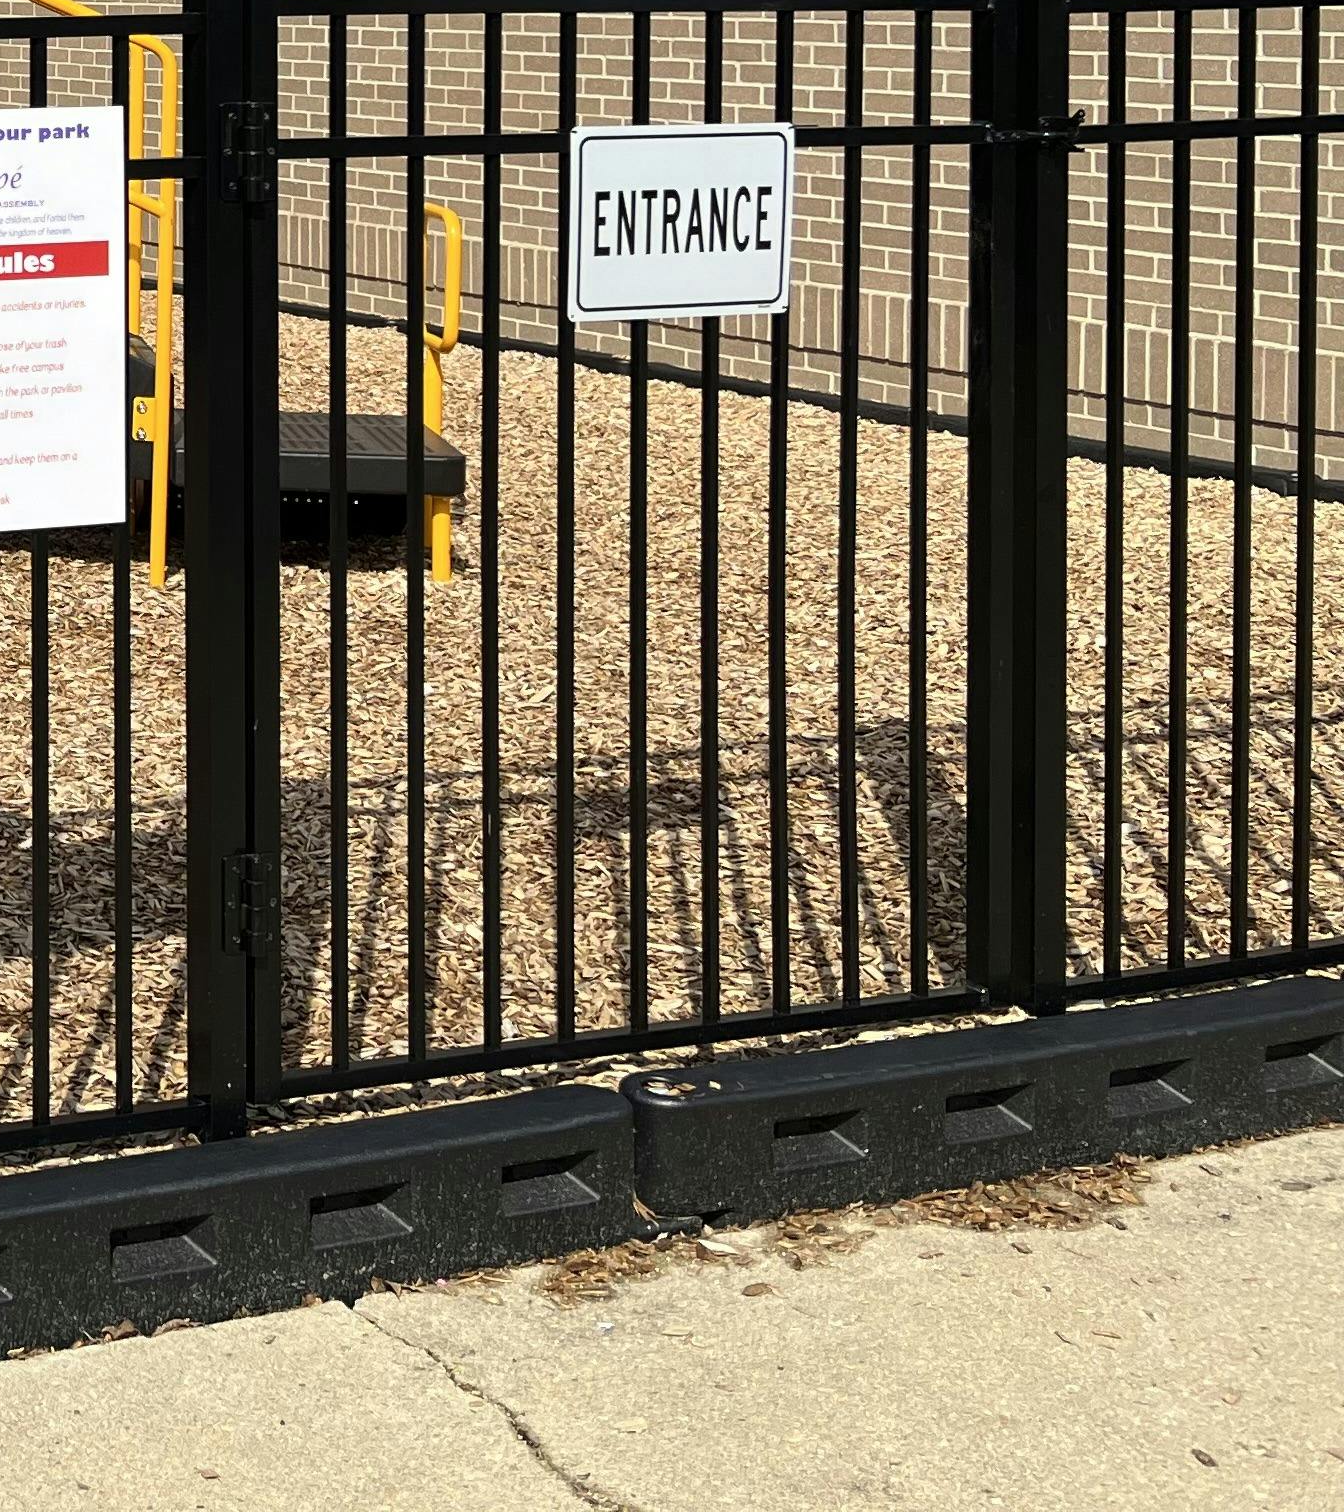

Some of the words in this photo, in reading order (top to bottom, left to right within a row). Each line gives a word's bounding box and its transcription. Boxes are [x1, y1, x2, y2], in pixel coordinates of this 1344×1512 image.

[39, 123, 90, 141] park
[594, 186, 772, 256] ENTRANCE
[1, 300, 43, 312] accidents
[44, 301, 53, 310] or
[15, 340, 24, 350] of
[24, 341, 44, 352] your
[11, 363, 30, 374] free
[31, 362, 65, 374] campus
[5, 386, 20, 397] the
[20, 385, 40, 399] park
[41, 386, 50, 395] or
[51, 383, 82, 397] pavilion
[10, 408, 33, 419] times
[14, 454, 36, 467] keep
[37, 453, 59, 464] them
[60, 452, 71, 462] on
